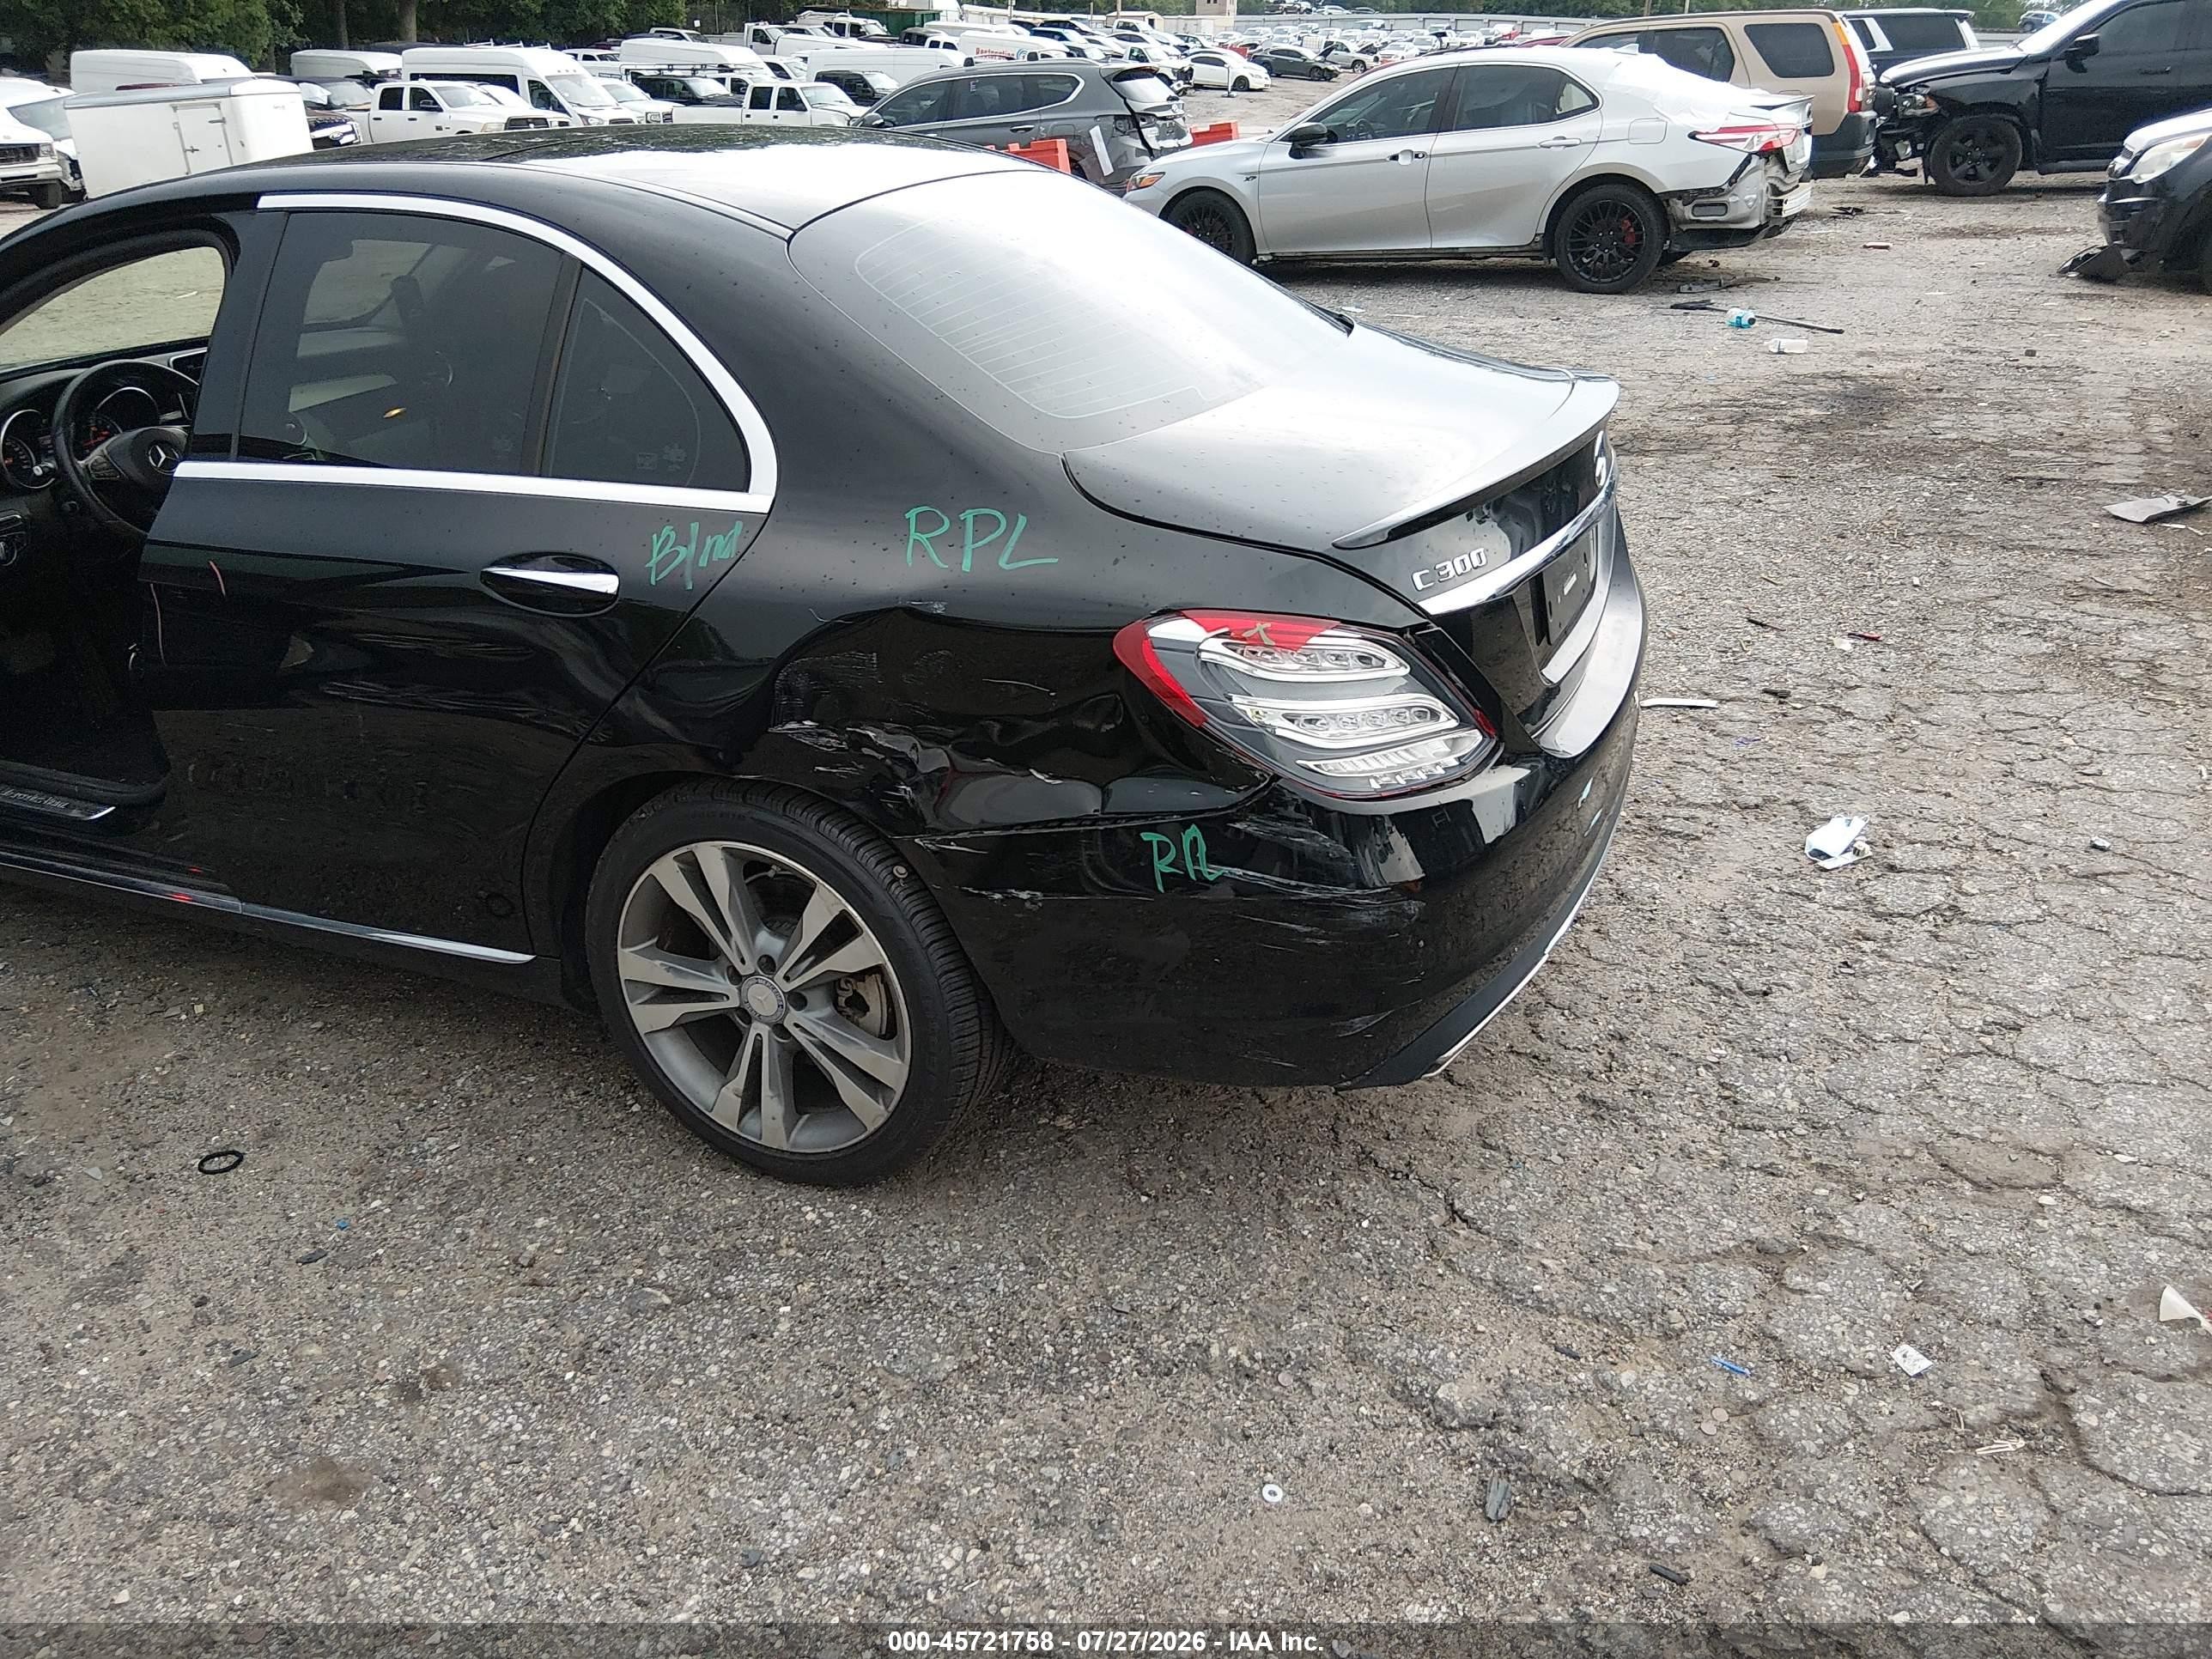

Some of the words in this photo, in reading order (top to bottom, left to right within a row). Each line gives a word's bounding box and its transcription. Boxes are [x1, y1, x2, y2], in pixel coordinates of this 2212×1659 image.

[904, 506, 1059, 573] RPL
[1411, 568, 1435, 591] C
[1433, 547, 1488, 583] 300
